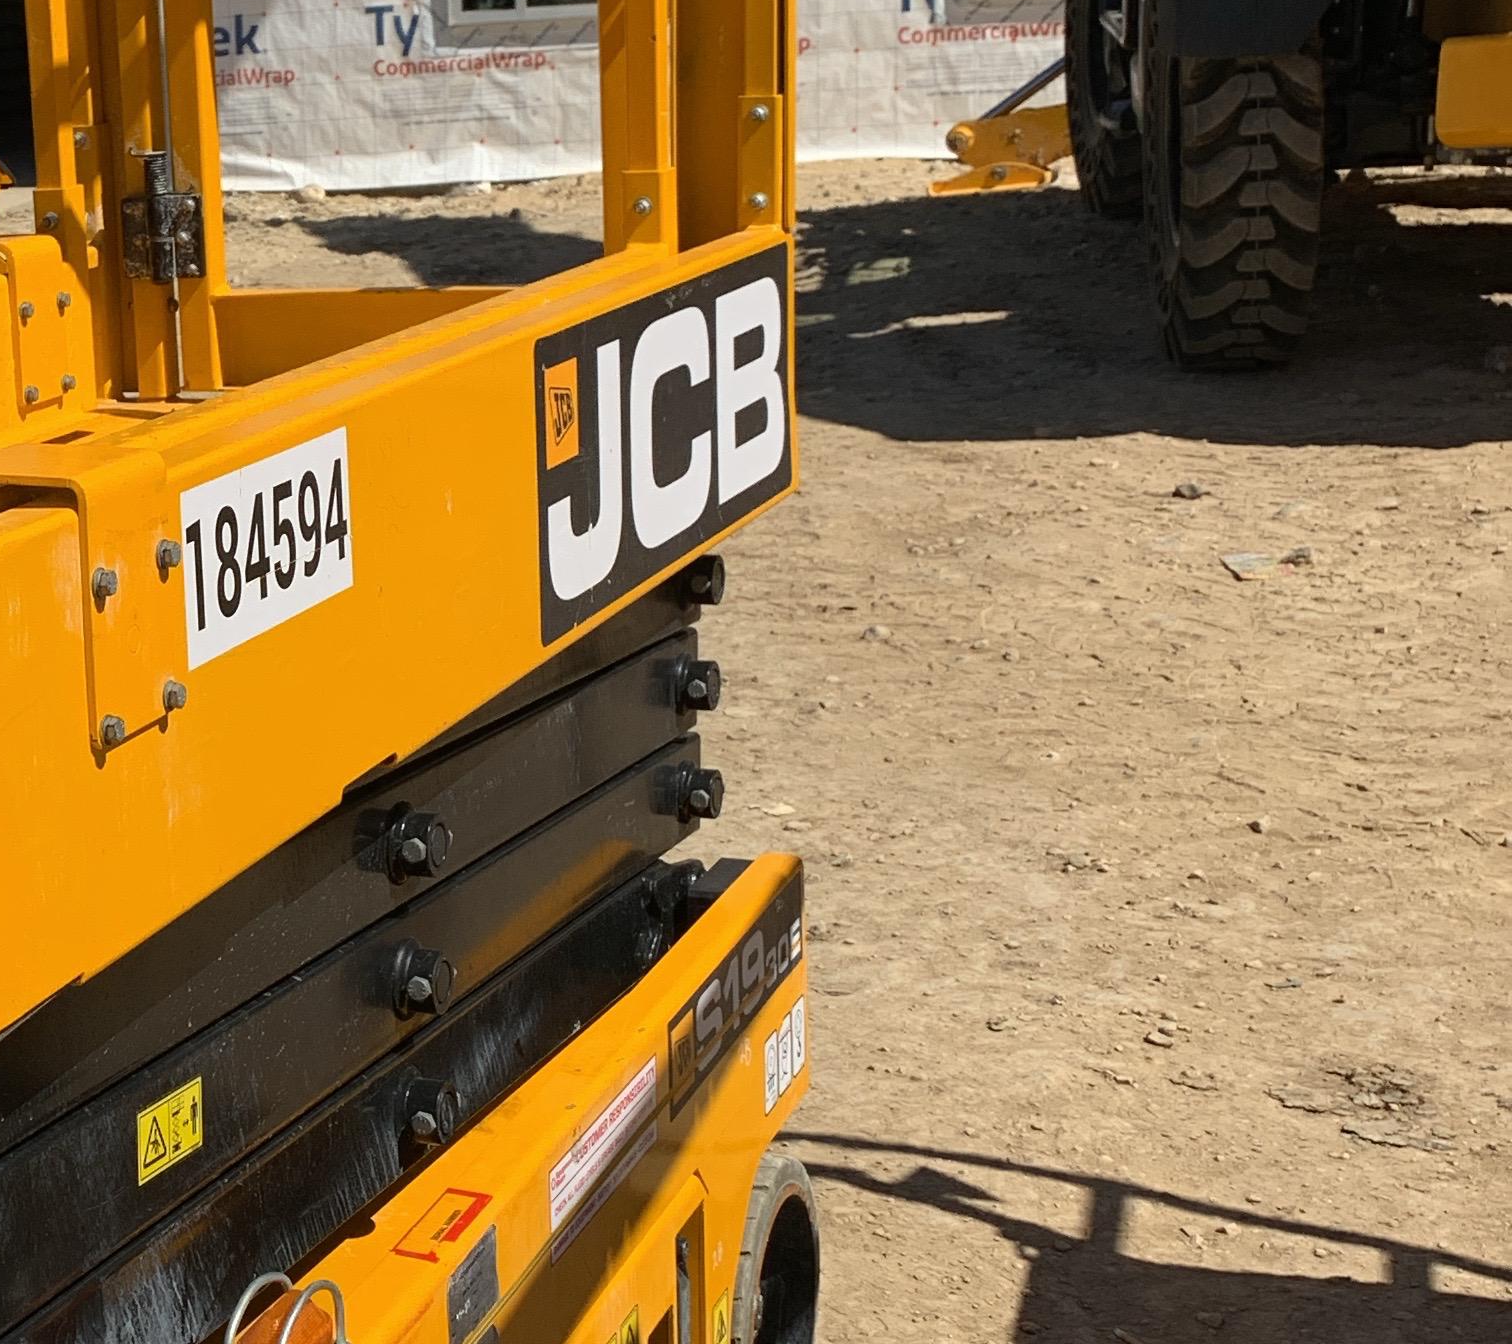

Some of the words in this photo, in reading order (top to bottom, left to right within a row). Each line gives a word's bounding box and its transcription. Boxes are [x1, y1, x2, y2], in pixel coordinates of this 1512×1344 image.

[548, 277, 786, 601] JCB
[552, 391, 574, 433] JCB
[185, 458, 348, 632] 184594
